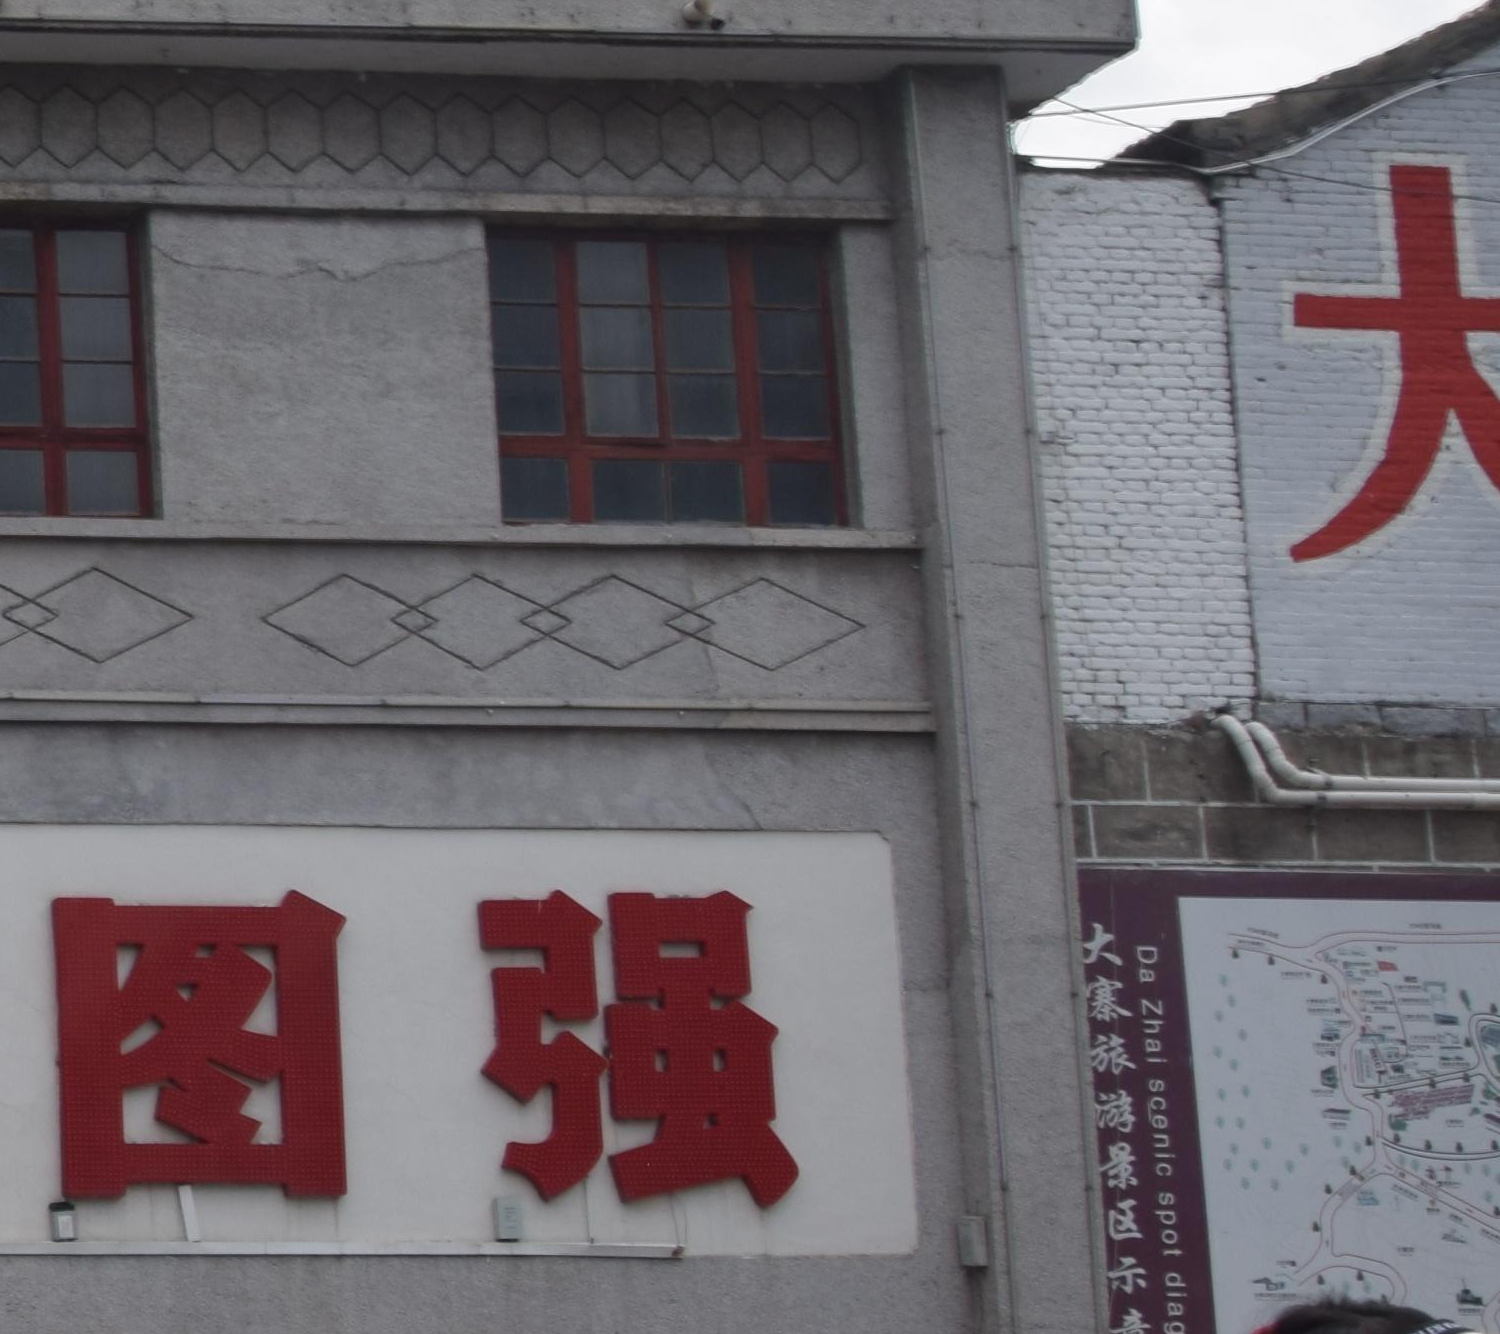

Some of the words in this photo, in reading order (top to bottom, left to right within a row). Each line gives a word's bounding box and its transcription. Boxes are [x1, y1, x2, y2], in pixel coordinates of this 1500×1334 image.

[1134, 945, 1159, 984] Da
[1141, 998, 1168, 1063] Zhai
[1148, 1078, 1176, 1177] scenic
[1155, 1192, 1183, 1257] spot
